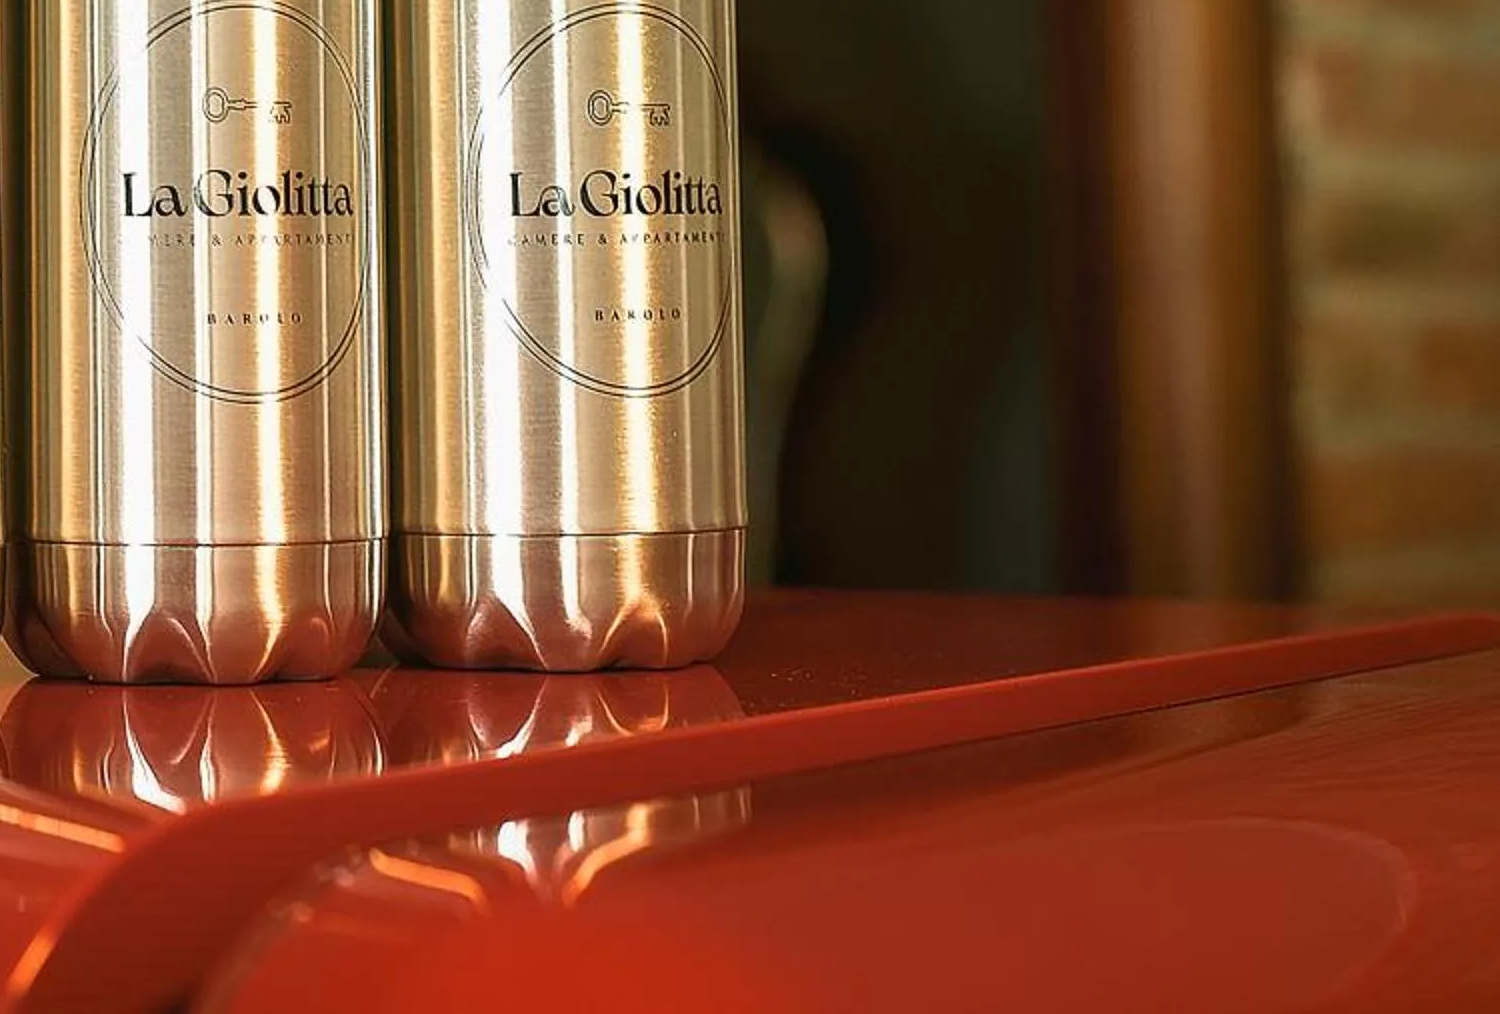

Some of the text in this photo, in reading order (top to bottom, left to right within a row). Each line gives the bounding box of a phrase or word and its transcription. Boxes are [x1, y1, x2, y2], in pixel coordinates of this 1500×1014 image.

[121, 169, 354, 217] La Giolitta
[509, 170, 723, 217] La Giolitta
[597, 233, 608, 246] &
[207, 312, 302, 325] BAROLO
[595, 308, 681, 322] BAROLO
